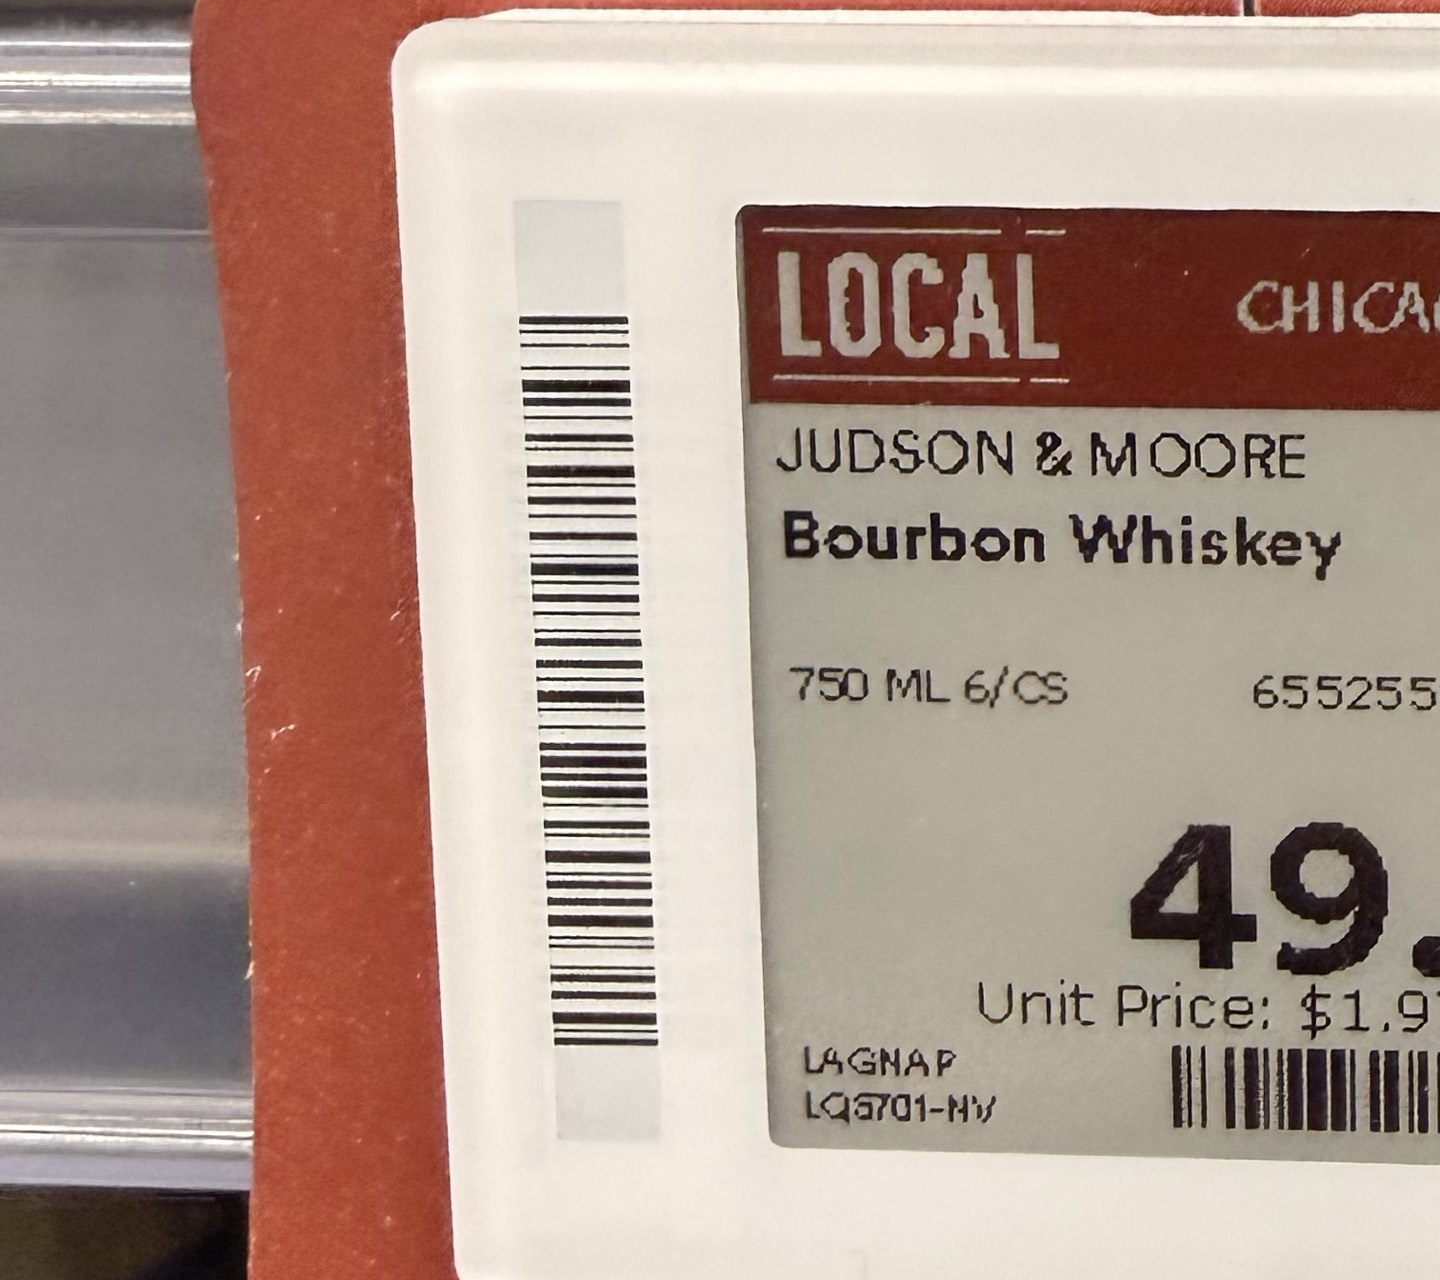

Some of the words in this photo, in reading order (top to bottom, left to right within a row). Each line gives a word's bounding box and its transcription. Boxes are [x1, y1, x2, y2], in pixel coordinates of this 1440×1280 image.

[778, 251, 1060, 359] LOCAL
[775, 427, 1014, 476] JUDSON
[1035, 431, 1073, 477] &
[1090, 431, 1307, 480] MOORE
[783, 509, 1046, 563] Bourbon
[1068, 513, 1342, 581] Whiskey
[789, 666, 869, 702] 750
[885, 668, 951, 704] ML
[964, 665, 1069, 709] 6/CS
[977, 978, 1096, 1027] Unit
[1117, 981, 1270, 1031] Price:
[803, 1045, 957, 1078] LAGNAP
